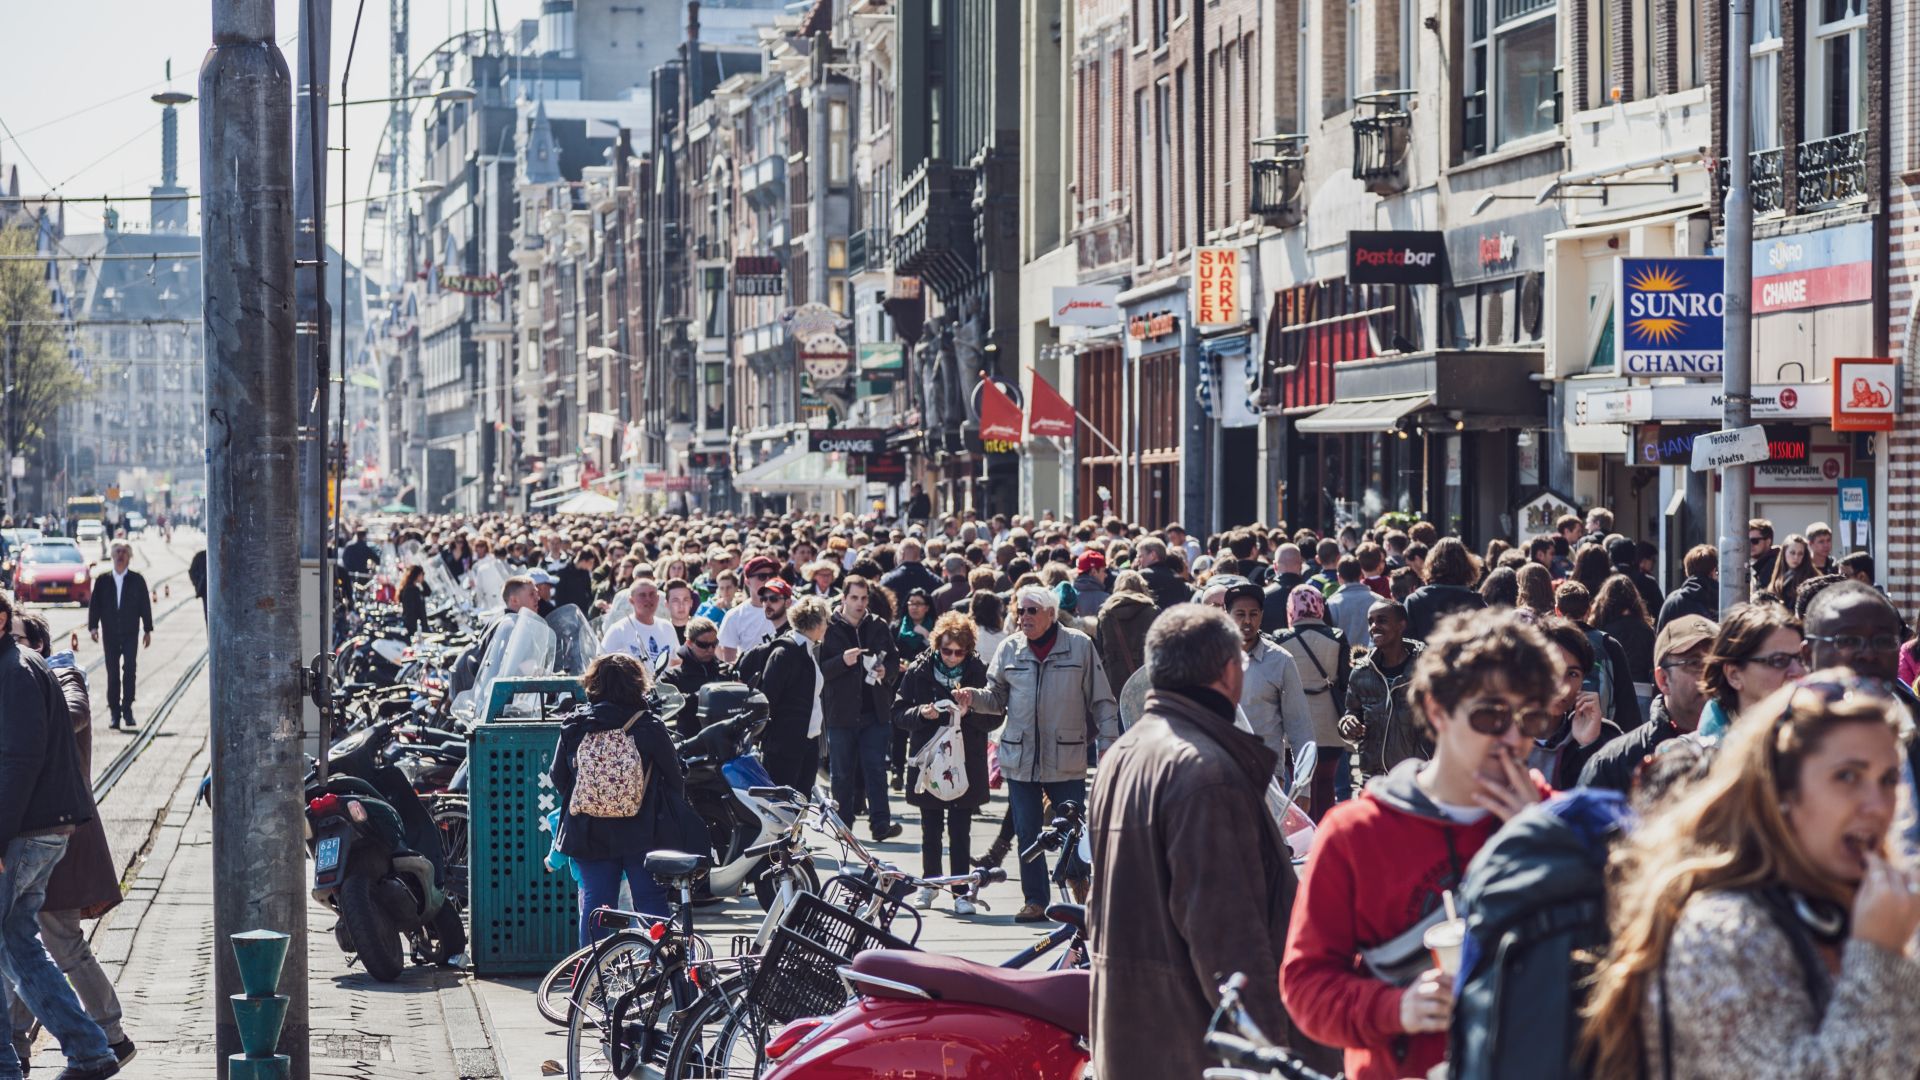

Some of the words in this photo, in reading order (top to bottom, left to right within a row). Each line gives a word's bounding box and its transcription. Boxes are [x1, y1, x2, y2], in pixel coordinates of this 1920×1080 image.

[1768, 244, 1803, 265] SUNRO
[736, 278, 780, 294] HOTEL
[1199, 251, 1214, 322] SUPER
[1217, 251, 1235, 322] MARKT
[1762, 279, 1807, 306] CHANGE
[819, 440, 873, 452] CHANGE
[1708, 457, 1716, 466] te
[1758, 464, 1820, 476] MoneyGram
